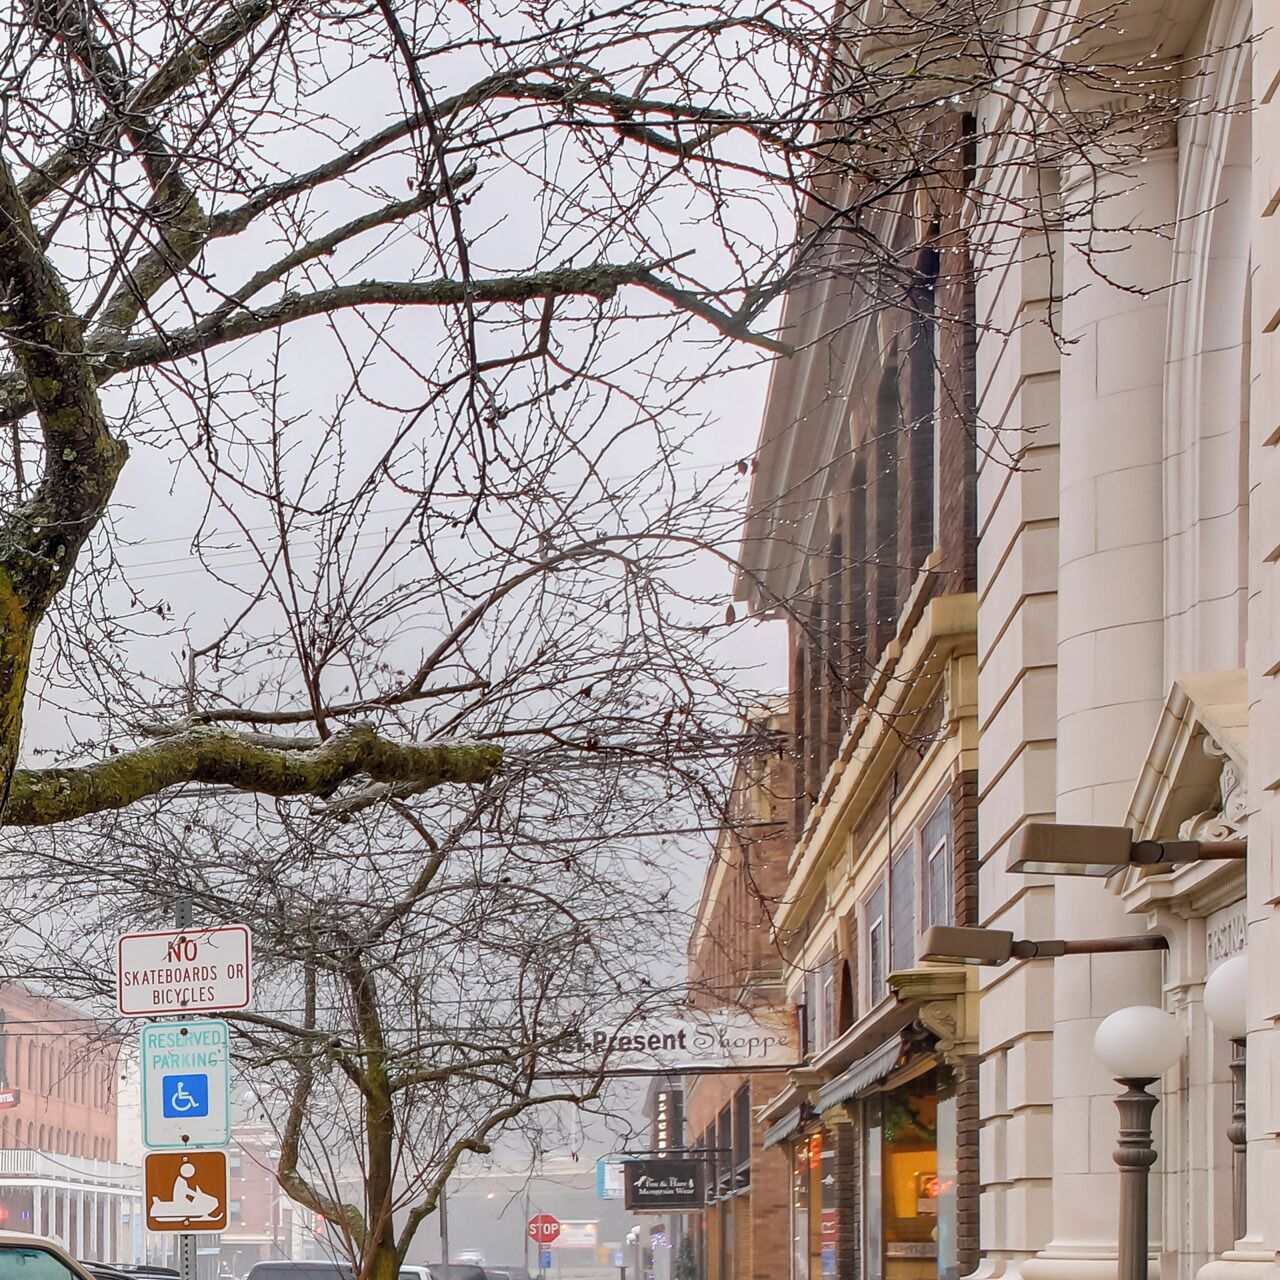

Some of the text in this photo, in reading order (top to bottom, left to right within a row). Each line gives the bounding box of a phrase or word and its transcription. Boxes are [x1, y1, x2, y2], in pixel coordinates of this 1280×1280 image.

[168, 939, 198, 963] NO
[124, 963, 244, 987] SKATEBOARDS OR
[153, 986, 215, 1005] BICYCLES
[148, 1030, 221, 1049] RESERVED
[693, 1022, 790, 1058] Shoppe
[153, 1052, 218, 1070] PARKING
[529, 1223, 559, 1235] STOP
